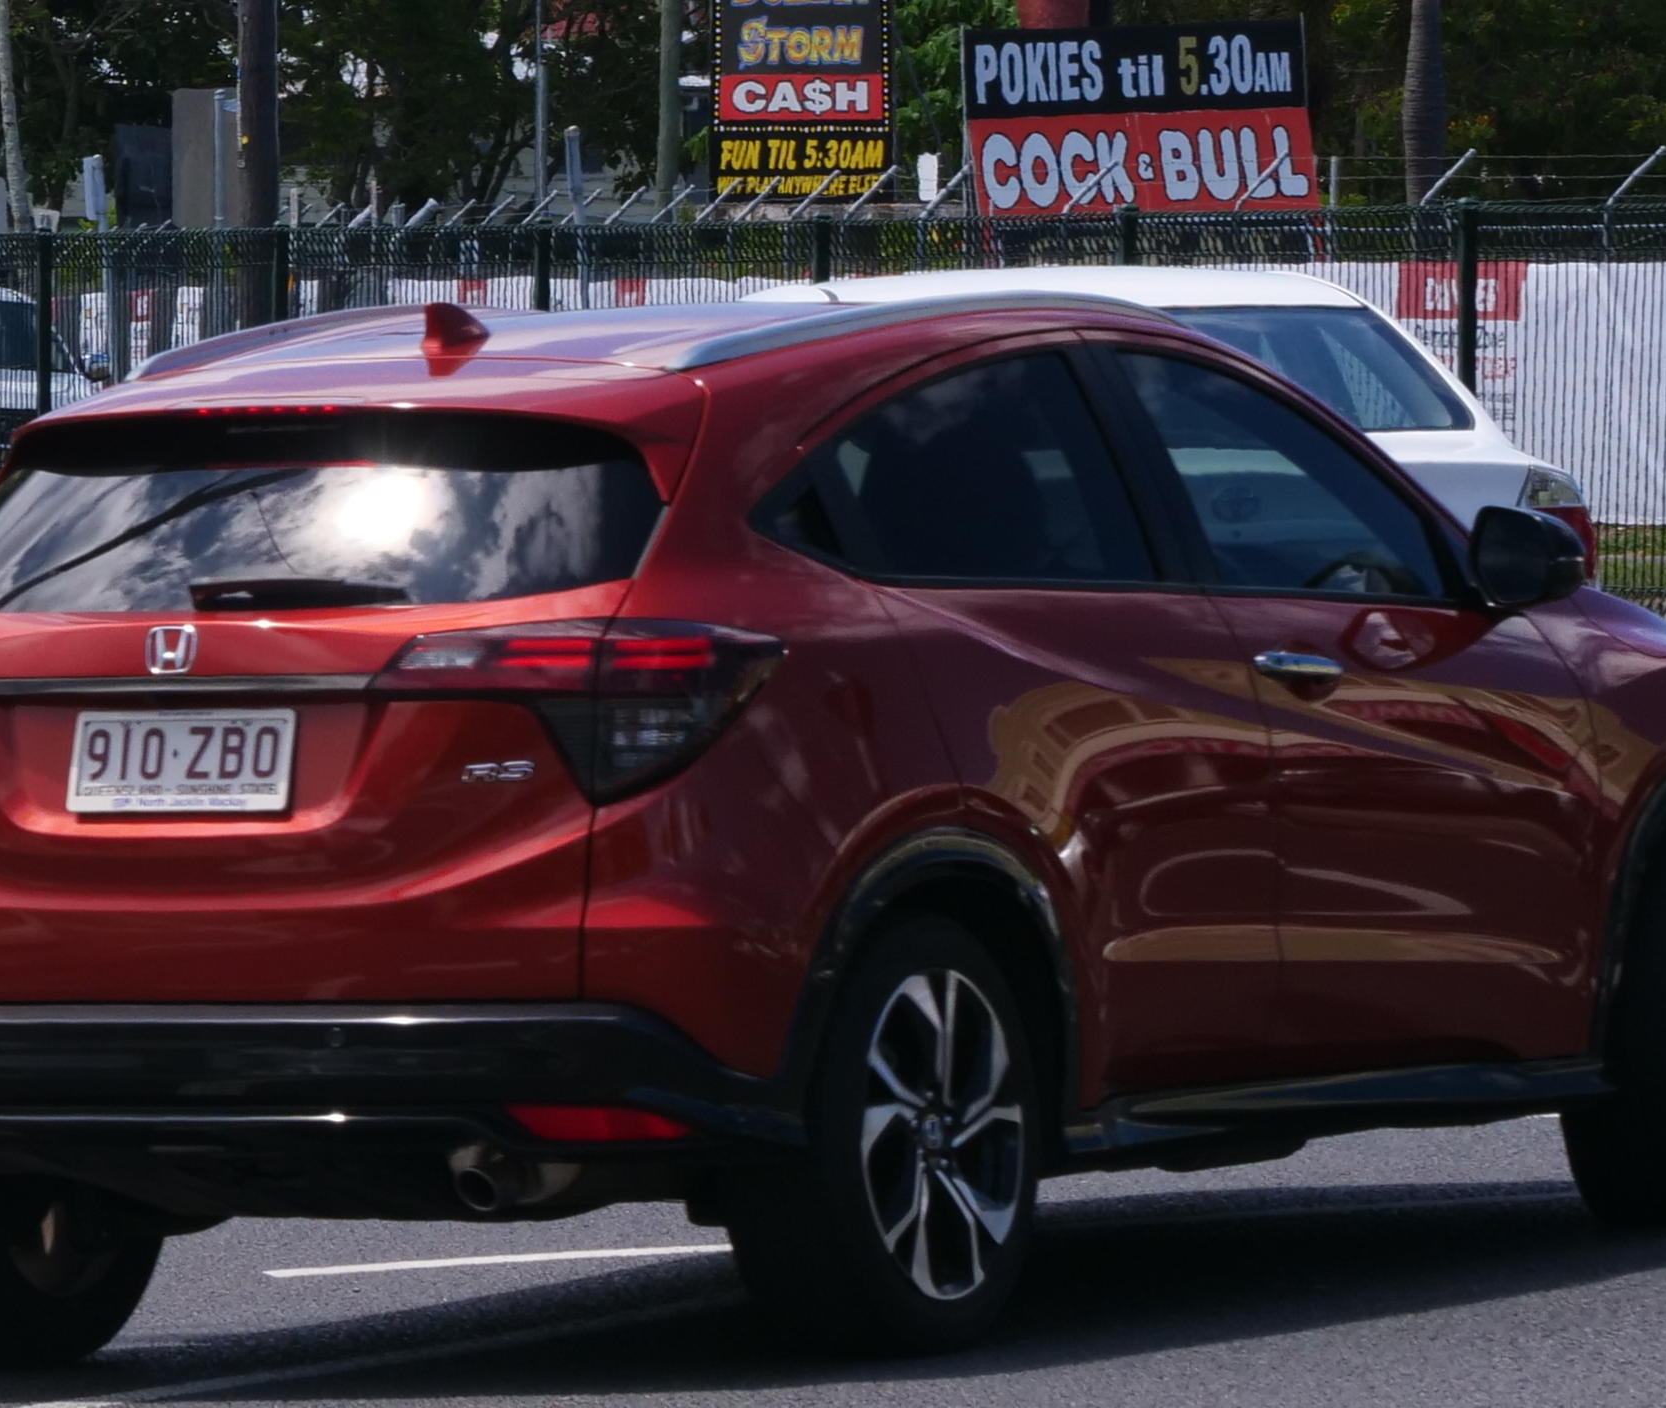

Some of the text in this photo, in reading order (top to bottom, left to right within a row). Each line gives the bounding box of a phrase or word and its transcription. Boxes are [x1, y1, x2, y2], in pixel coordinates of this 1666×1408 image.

[737, 15, 864, 70] STORM
[975, 34, 1292, 104] POKIES til 5.30AM
[732, 79, 869, 115] CA$H
[720, 139, 883, 170] FUN TIL 5:30AM
[982, 125, 1308, 209] COCK & BULL
[461, 760, 535, 782] RS
